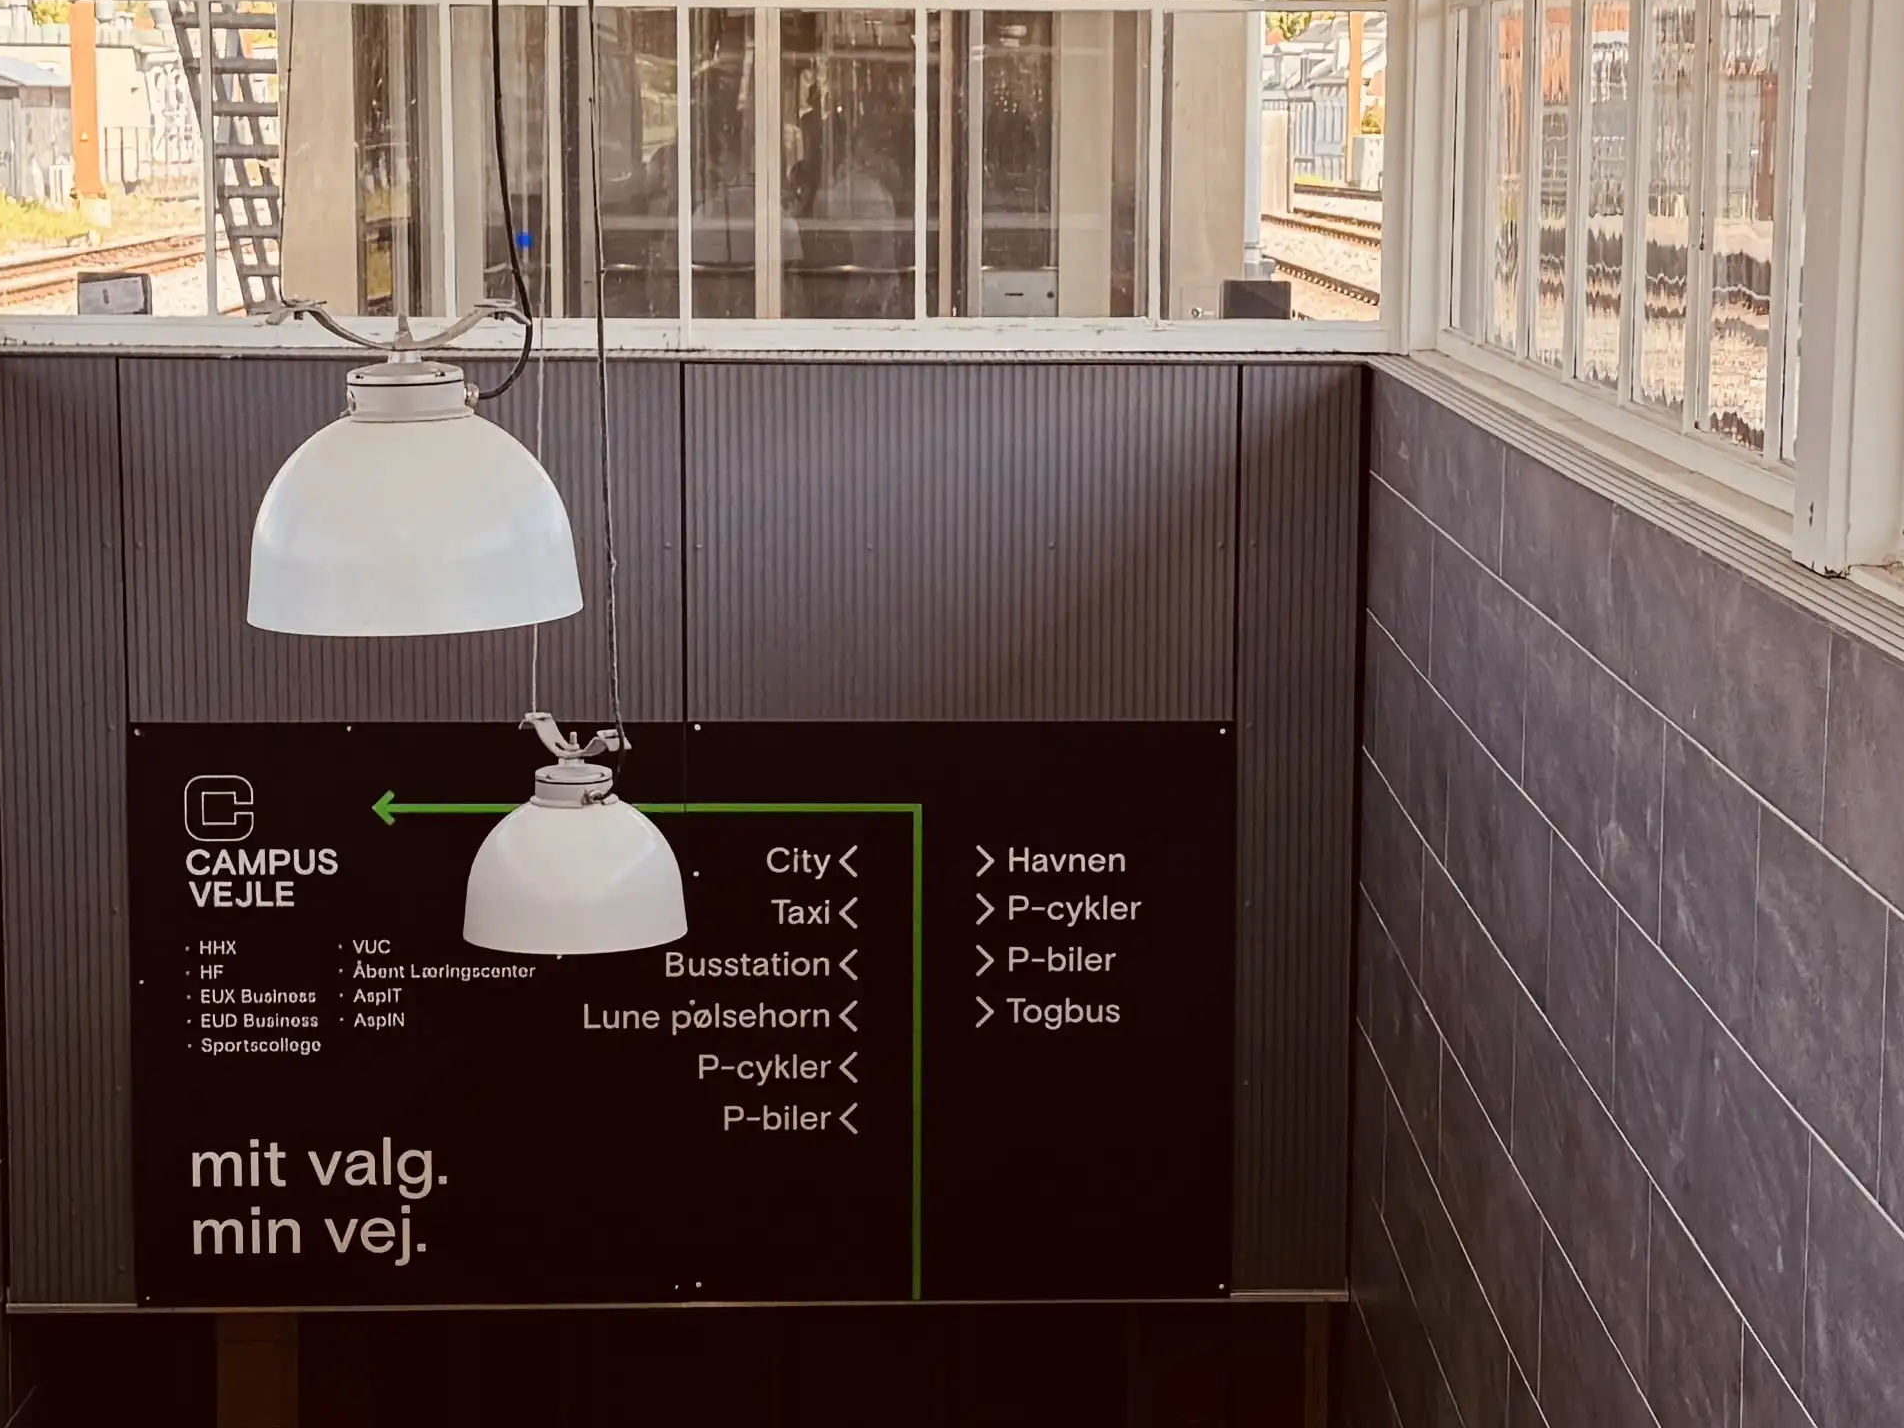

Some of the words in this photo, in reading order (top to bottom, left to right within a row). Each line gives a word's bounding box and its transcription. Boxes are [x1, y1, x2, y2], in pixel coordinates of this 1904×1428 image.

[186, 848, 338, 875] CAMPUS
[767, 847, 831, 880] City
[1009, 847, 1125, 872] Havnen
[189, 881, 294, 907] VEJLE
[771, 899, 829, 924] Taxi
[1009, 895, 1141, 927] P-cykler
[200, 940, 236, 955] HHX
[353, 940, 390, 954] VUC
[1009, 946, 1116, 972] P-biler
[201, 965, 223, 979] HF
[353, 960, 404, 978] Åbent
[411, 964, 535, 981] Læringscenter
[666, 952, 829, 977] Busstation
[201, 989, 235, 1004] EUX
[242, 989, 316, 1003] Business
[353, 988, 402, 1005] AspIT
[201, 1013, 237, 1028] EUD
[244, 1013, 318, 1028] Business
[354, 1012, 404, 1030] AspIN
[582, 1004, 660, 1030] Lune
[670, 1004, 831, 1036] pølsehorn
[1007, 998, 1120, 1030] Togbus
[202, 1038, 321, 1055] Sportscollege
[699, 1054, 831, 1086] P-cykler
[724, 1105, 831, 1130] P-biler
[192, 1139, 286, 1187] mit
[308, 1137, 447, 1199] valg.
[192, 1206, 301, 1255] min
[325, 1204, 427, 1266] vej.
